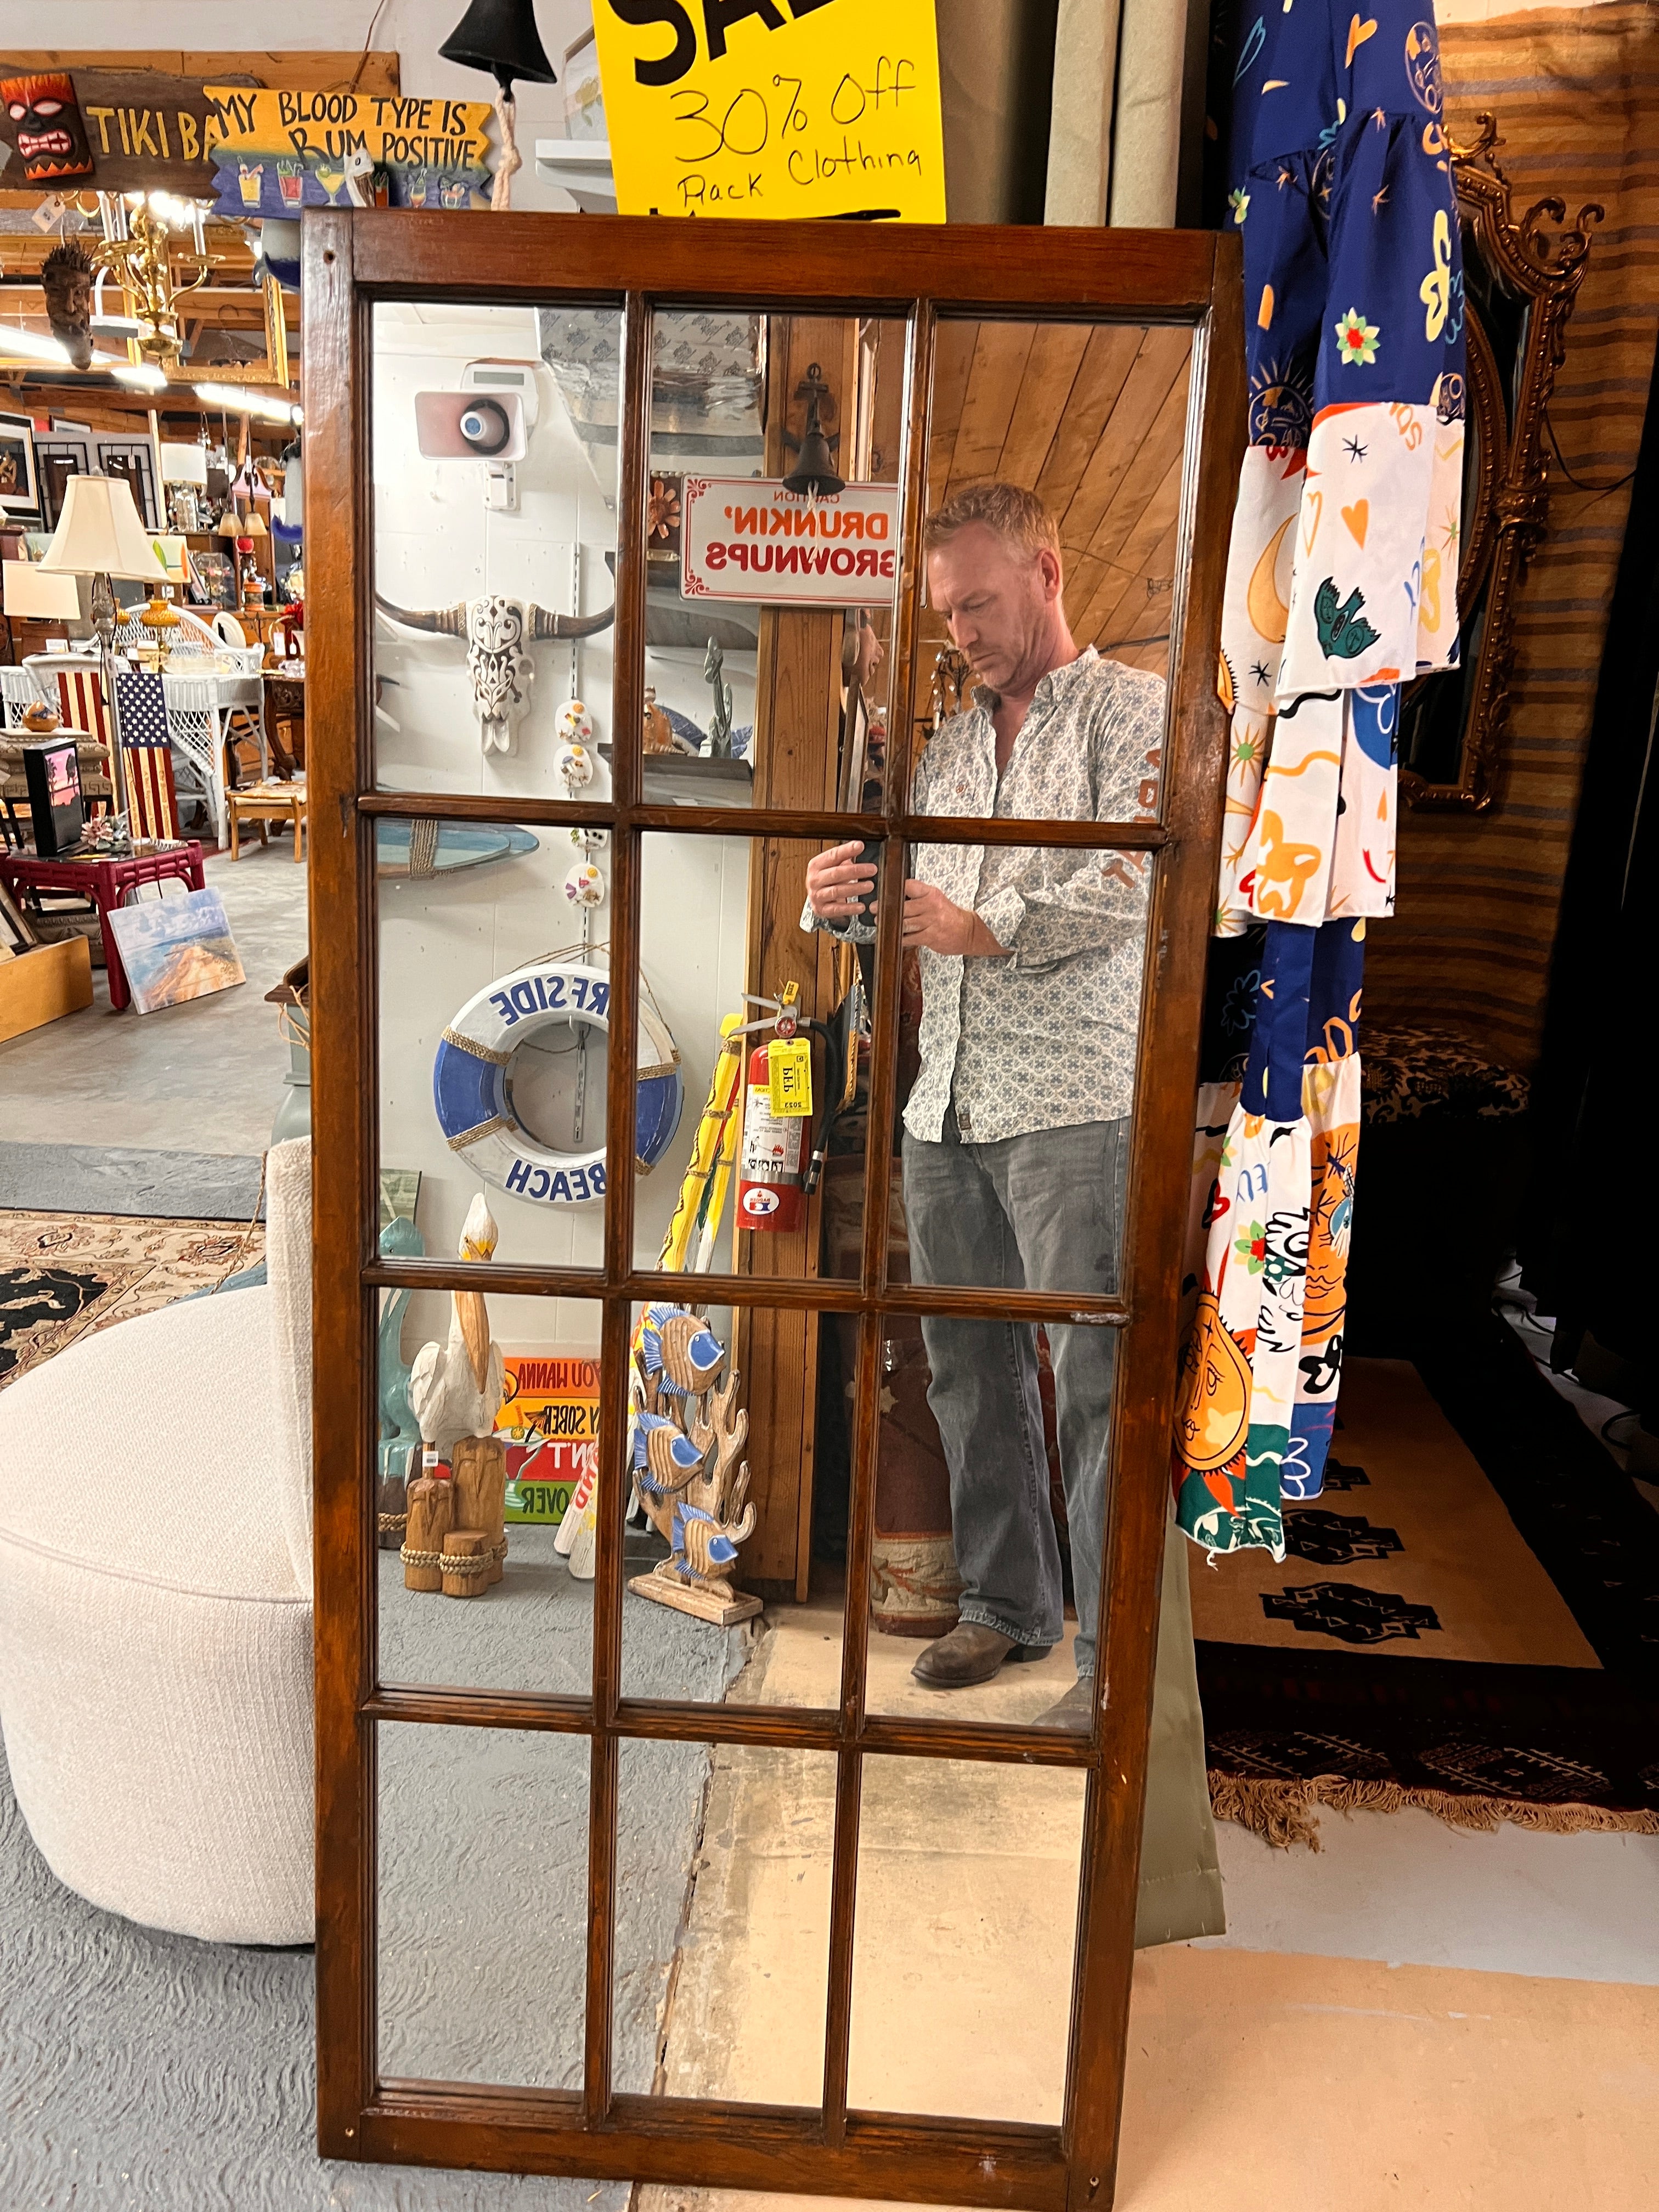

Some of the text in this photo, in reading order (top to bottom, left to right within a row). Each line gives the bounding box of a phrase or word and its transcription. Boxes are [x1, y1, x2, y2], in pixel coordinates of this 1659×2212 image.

[86, 106, 170, 159] TIKI
[212, 91, 467, 139] MY BLOOD TYPE IS
[670, 56, 916, 162] 30% Off
[288, 127, 477, 173] RUM POSITIVE
[678, 136, 921, 207] Rack Clothing
